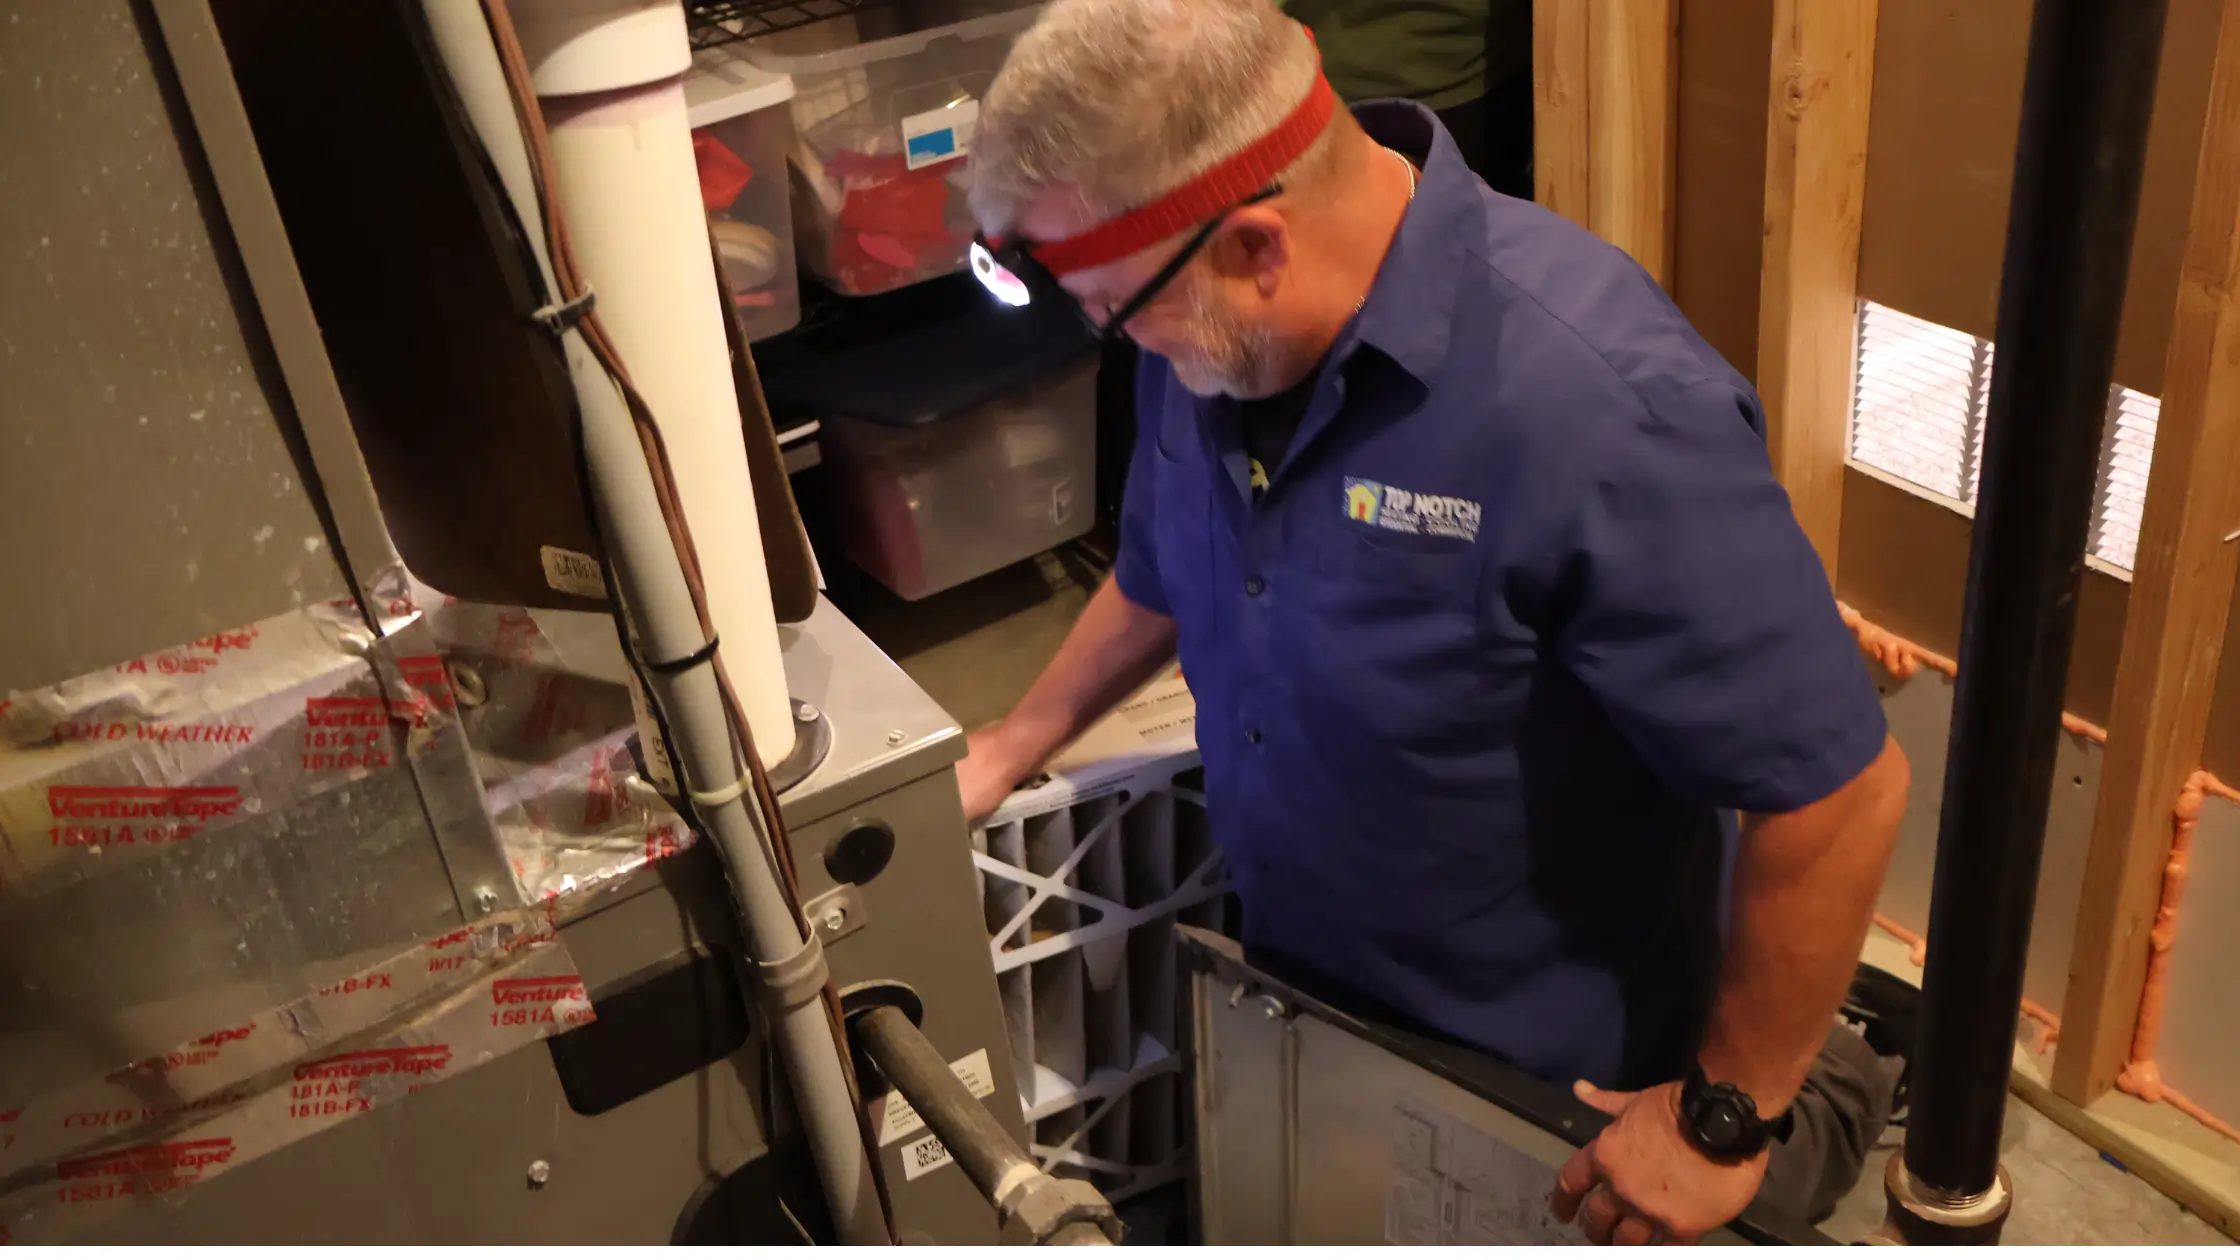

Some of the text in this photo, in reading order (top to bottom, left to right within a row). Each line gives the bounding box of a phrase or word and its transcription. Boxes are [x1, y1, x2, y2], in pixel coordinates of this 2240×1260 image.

[1413, 493, 1481, 525] NOTCH
[137, 723, 252, 744] WEATHER
[491, 1006, 555, 1028] 1581A
